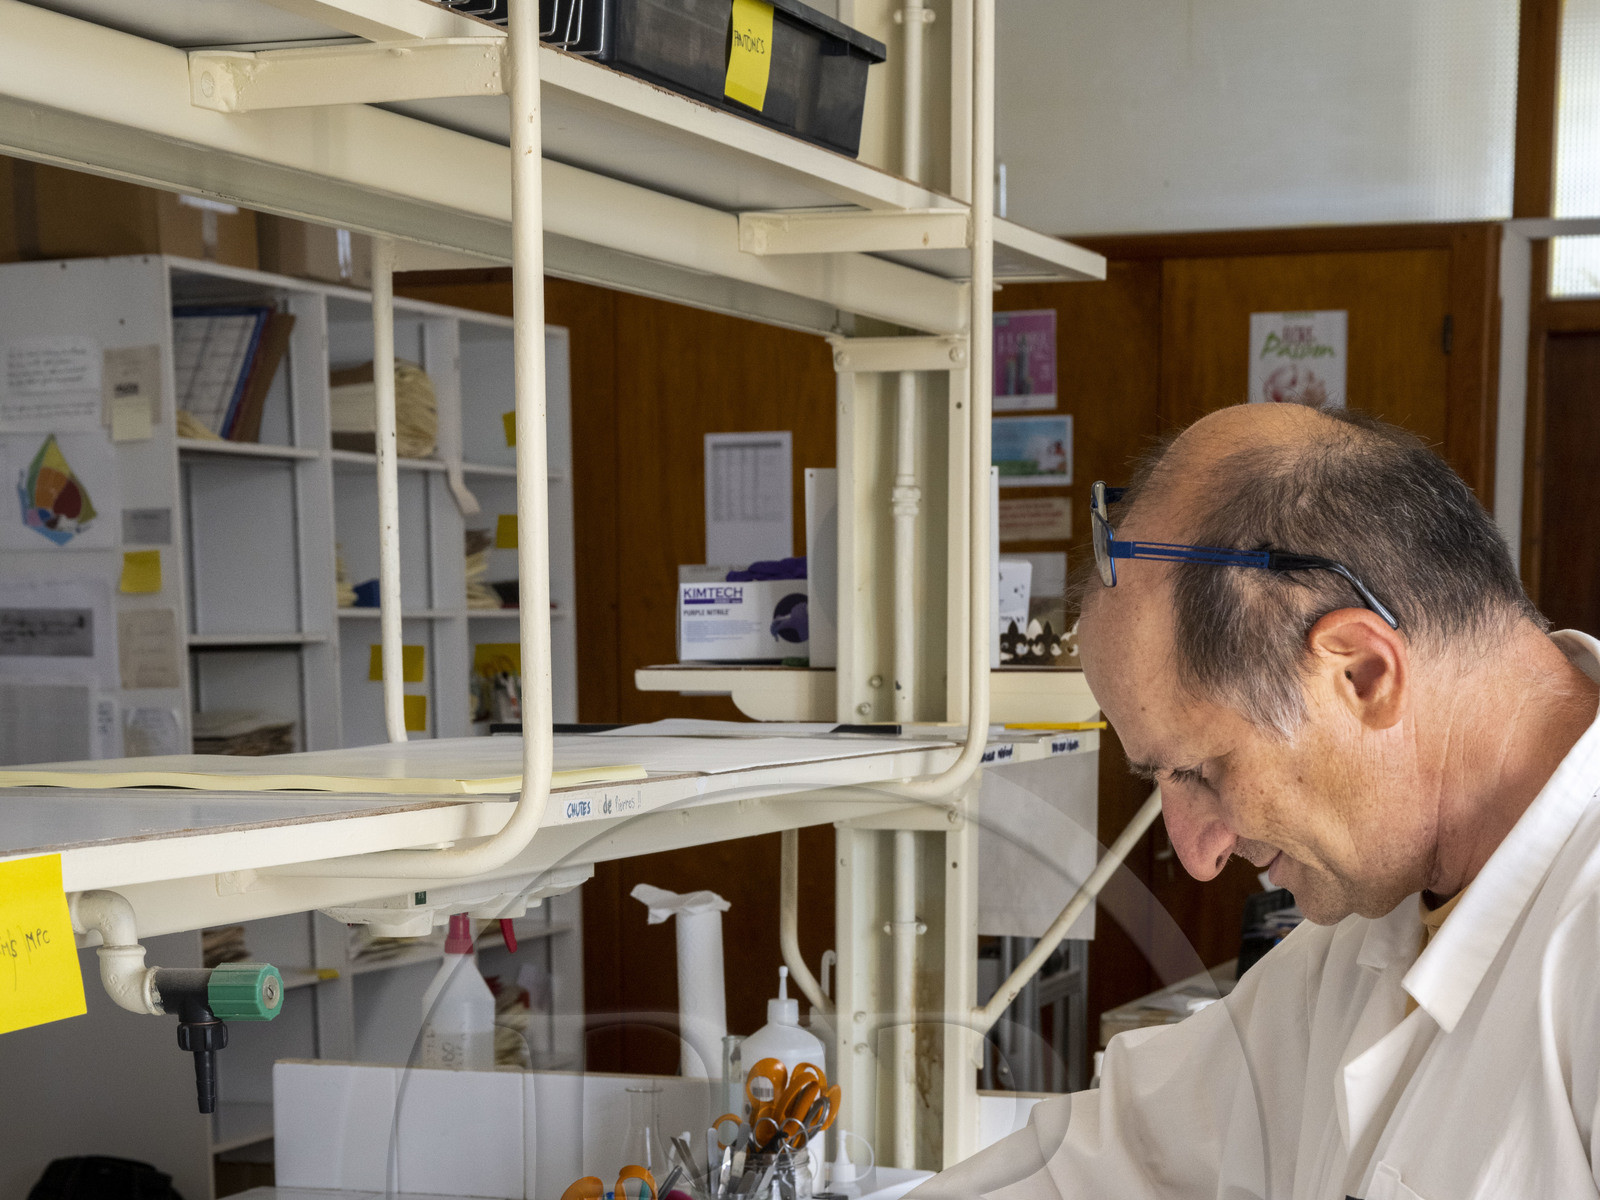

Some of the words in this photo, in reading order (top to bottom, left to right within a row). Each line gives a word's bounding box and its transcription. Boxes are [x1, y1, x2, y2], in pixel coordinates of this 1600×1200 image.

[683, 587, 743, 599] KIMTECH
[566, 801, 591, 818] CHUTES
[25, 928, 51, 952] MPC
